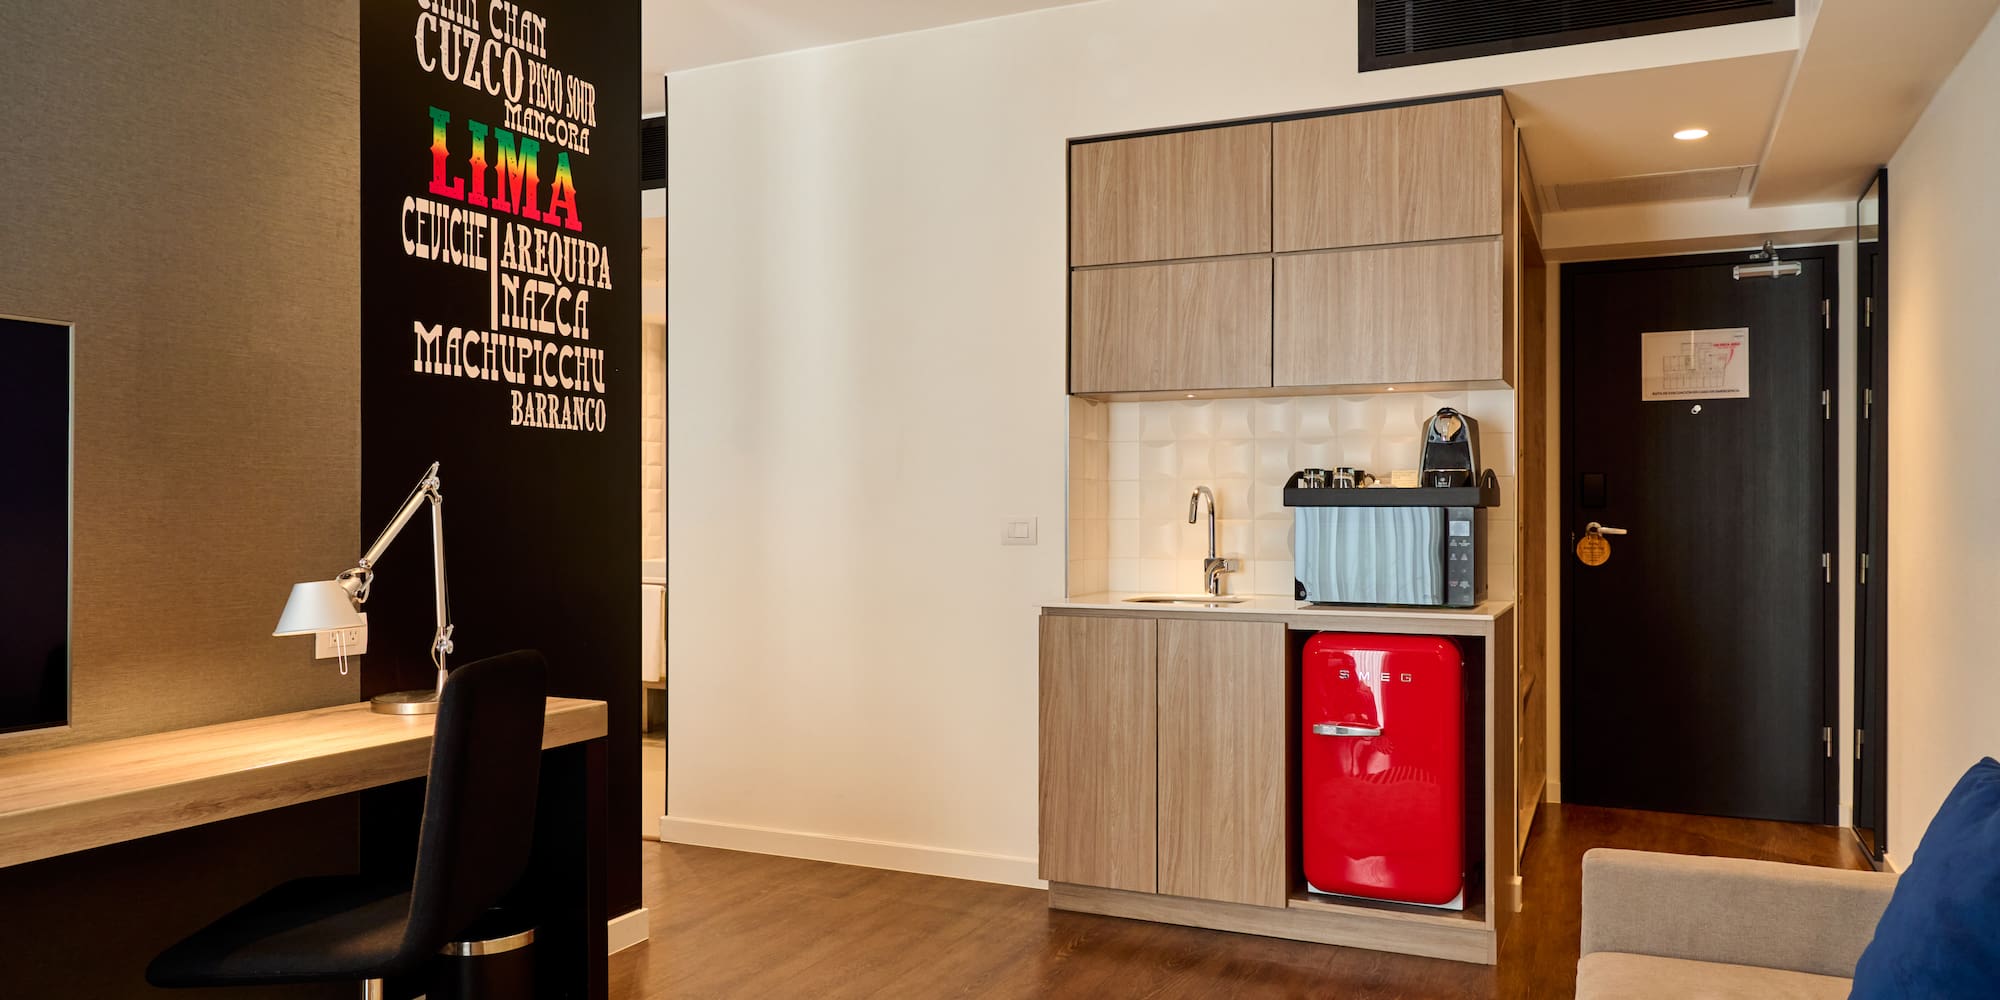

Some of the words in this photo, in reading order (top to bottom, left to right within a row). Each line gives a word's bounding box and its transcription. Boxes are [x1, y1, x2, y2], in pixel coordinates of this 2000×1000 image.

[415, 12, 524, 103] CUZCO
[489, 0, 546, 59] CHAN
[505, 99, 590, 155] MANCORA
[528, 59, 563, 114] PISCO
[566, 75, 596, 127] SOUR
[429, 106, 582, 232] LIMA
[402, 196, 487, 271] CEVICHE
[501, 222, 612, 290] AREQUIPA
[502, 273, 589, 340] NAZCA
[414, 321, 605, 393] MACHUPICCHU
[511, 390, 606, 432] BARRANCO
[1339, 670, 1412, 682] SMEG
